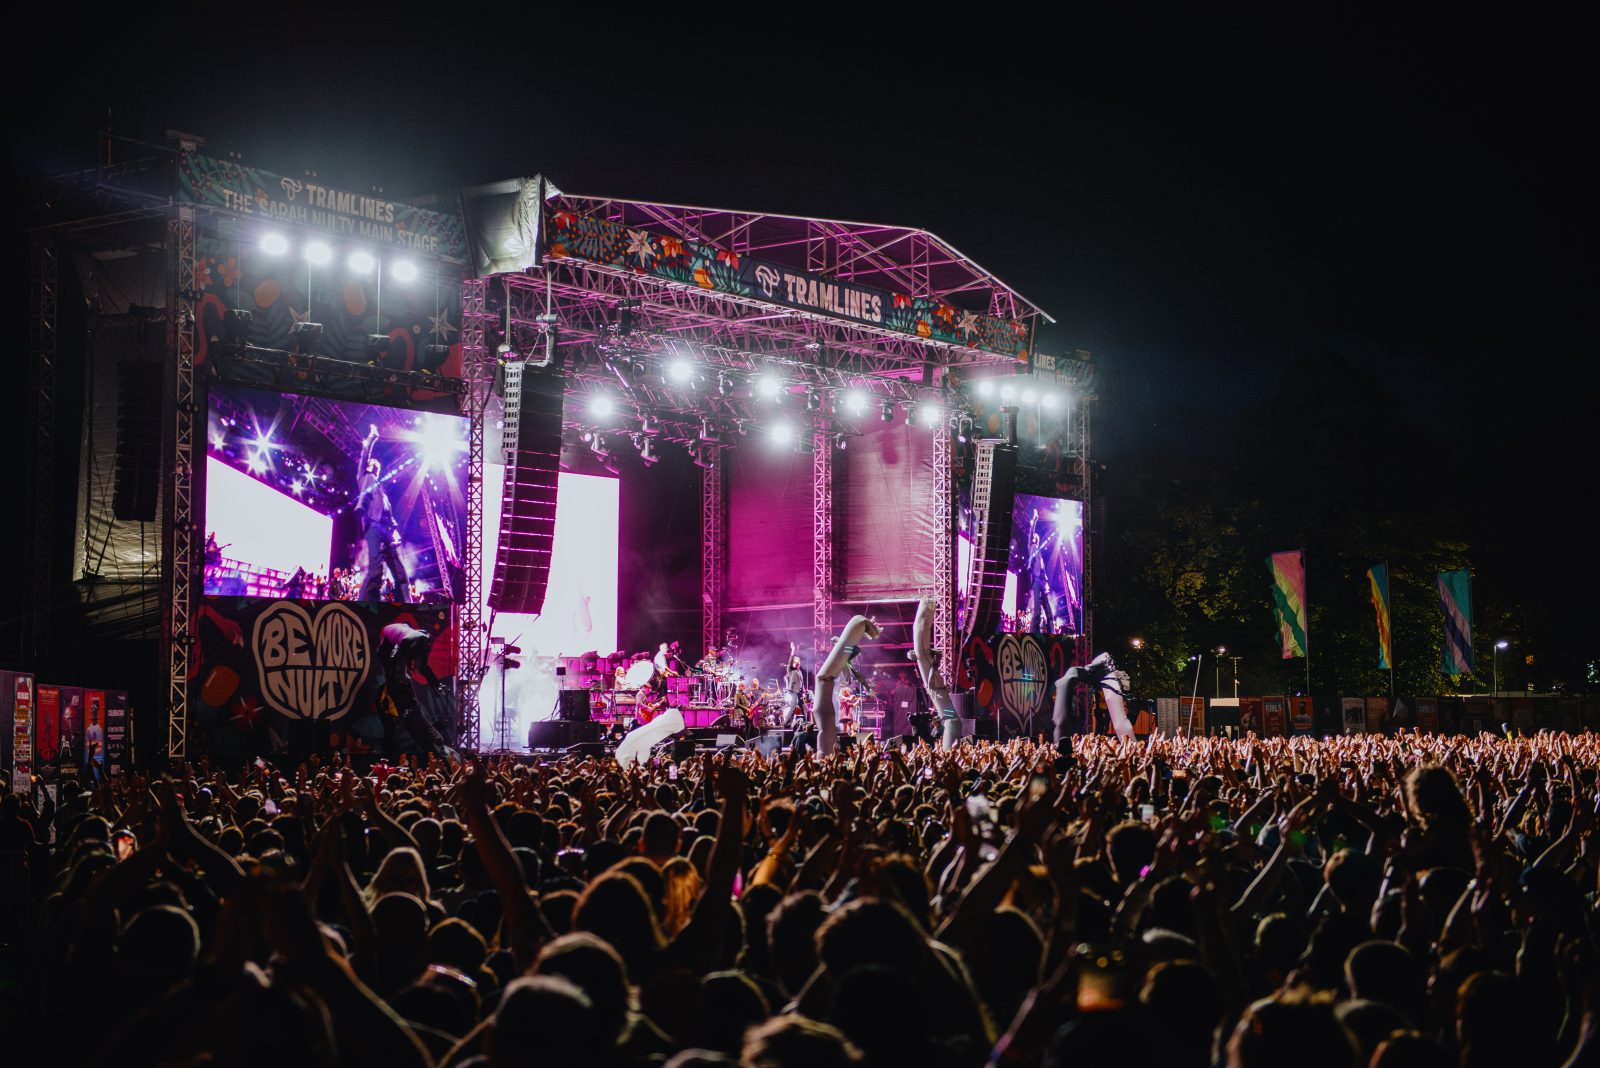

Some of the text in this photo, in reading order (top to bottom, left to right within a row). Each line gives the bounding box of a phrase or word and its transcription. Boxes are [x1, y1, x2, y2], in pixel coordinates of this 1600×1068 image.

[223, 189, 253, 213] THE
[359, 221, 392, 242] MAIN
[397, 229, 438, 251] STAGE
[307, 184, 394, 223] TRAMLINES
[784, 274, 881, 323] TRAMLINES
[1035, 353, 1056, 370] LINES
[263, 612, 364, 668] BE MORE
[1002, 643, 1022, 678] BE
[268, 669, 357, 720] NULTY
